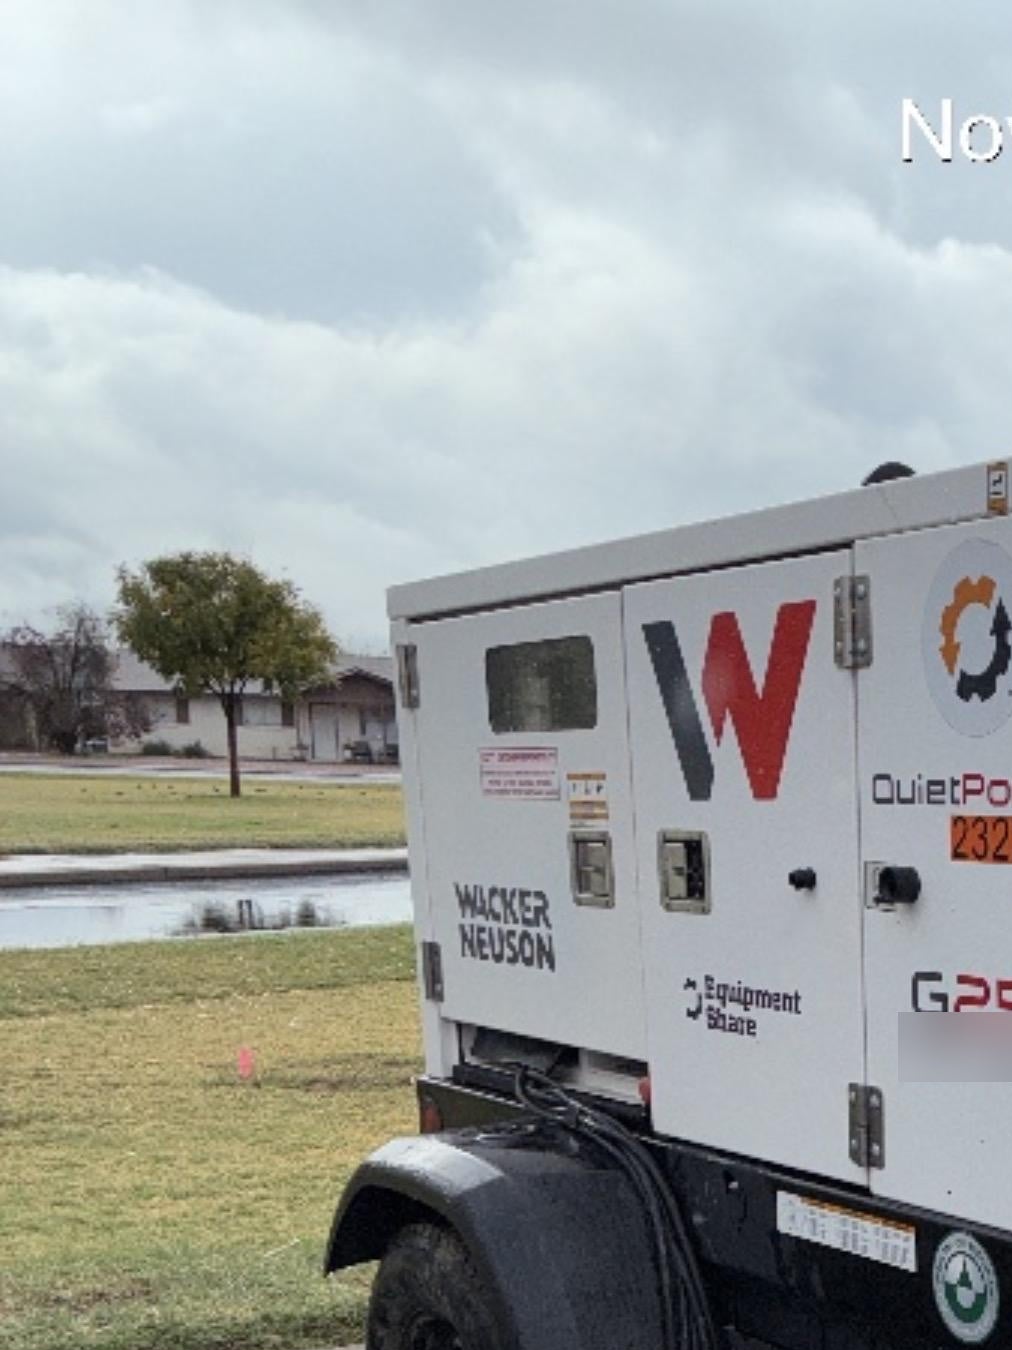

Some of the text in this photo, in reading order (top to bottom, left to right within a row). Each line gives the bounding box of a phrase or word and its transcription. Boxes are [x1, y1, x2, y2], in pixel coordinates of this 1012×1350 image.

[453, 882, 553, 930] WACKER
[459, 923, 556, 973] NEUSON
[704, 974, 802, 1015] Equipment
[705, 1004, 758, 1036] Share
